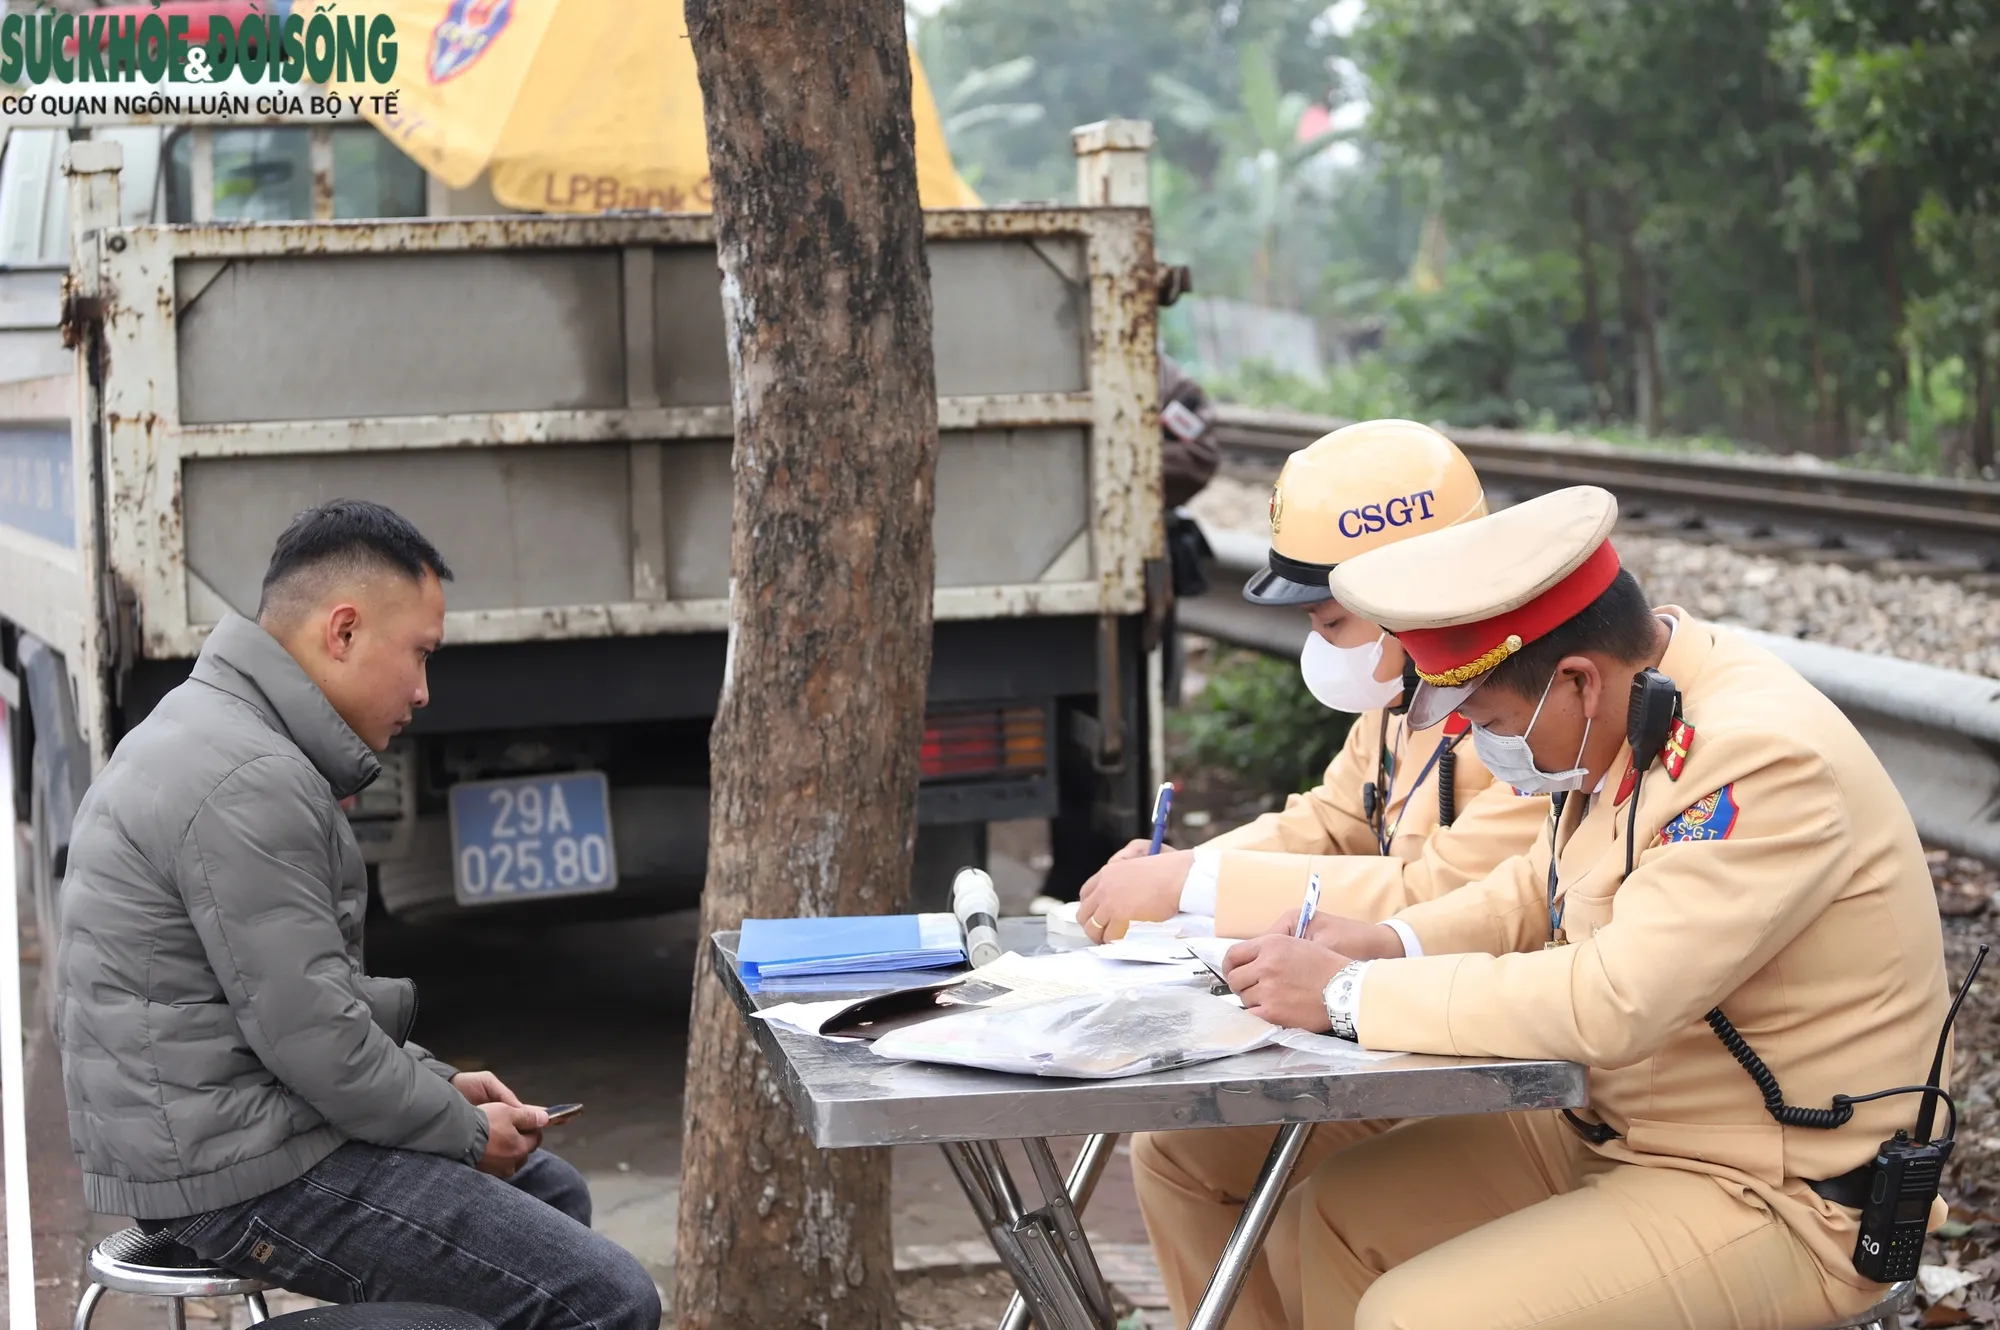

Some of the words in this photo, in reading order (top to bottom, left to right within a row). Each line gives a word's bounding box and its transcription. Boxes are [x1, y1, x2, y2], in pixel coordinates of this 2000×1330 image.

[545, 172, 686, 210] LPBank
[1338, 489, 1435, 538] CSGT
[489, 781, 573, 838] 29A
[1666, 822, 1718, 841] CSGT
[460, 834, 608, 895] 025.80
[1862, 1234, 1880, 1255] 20
